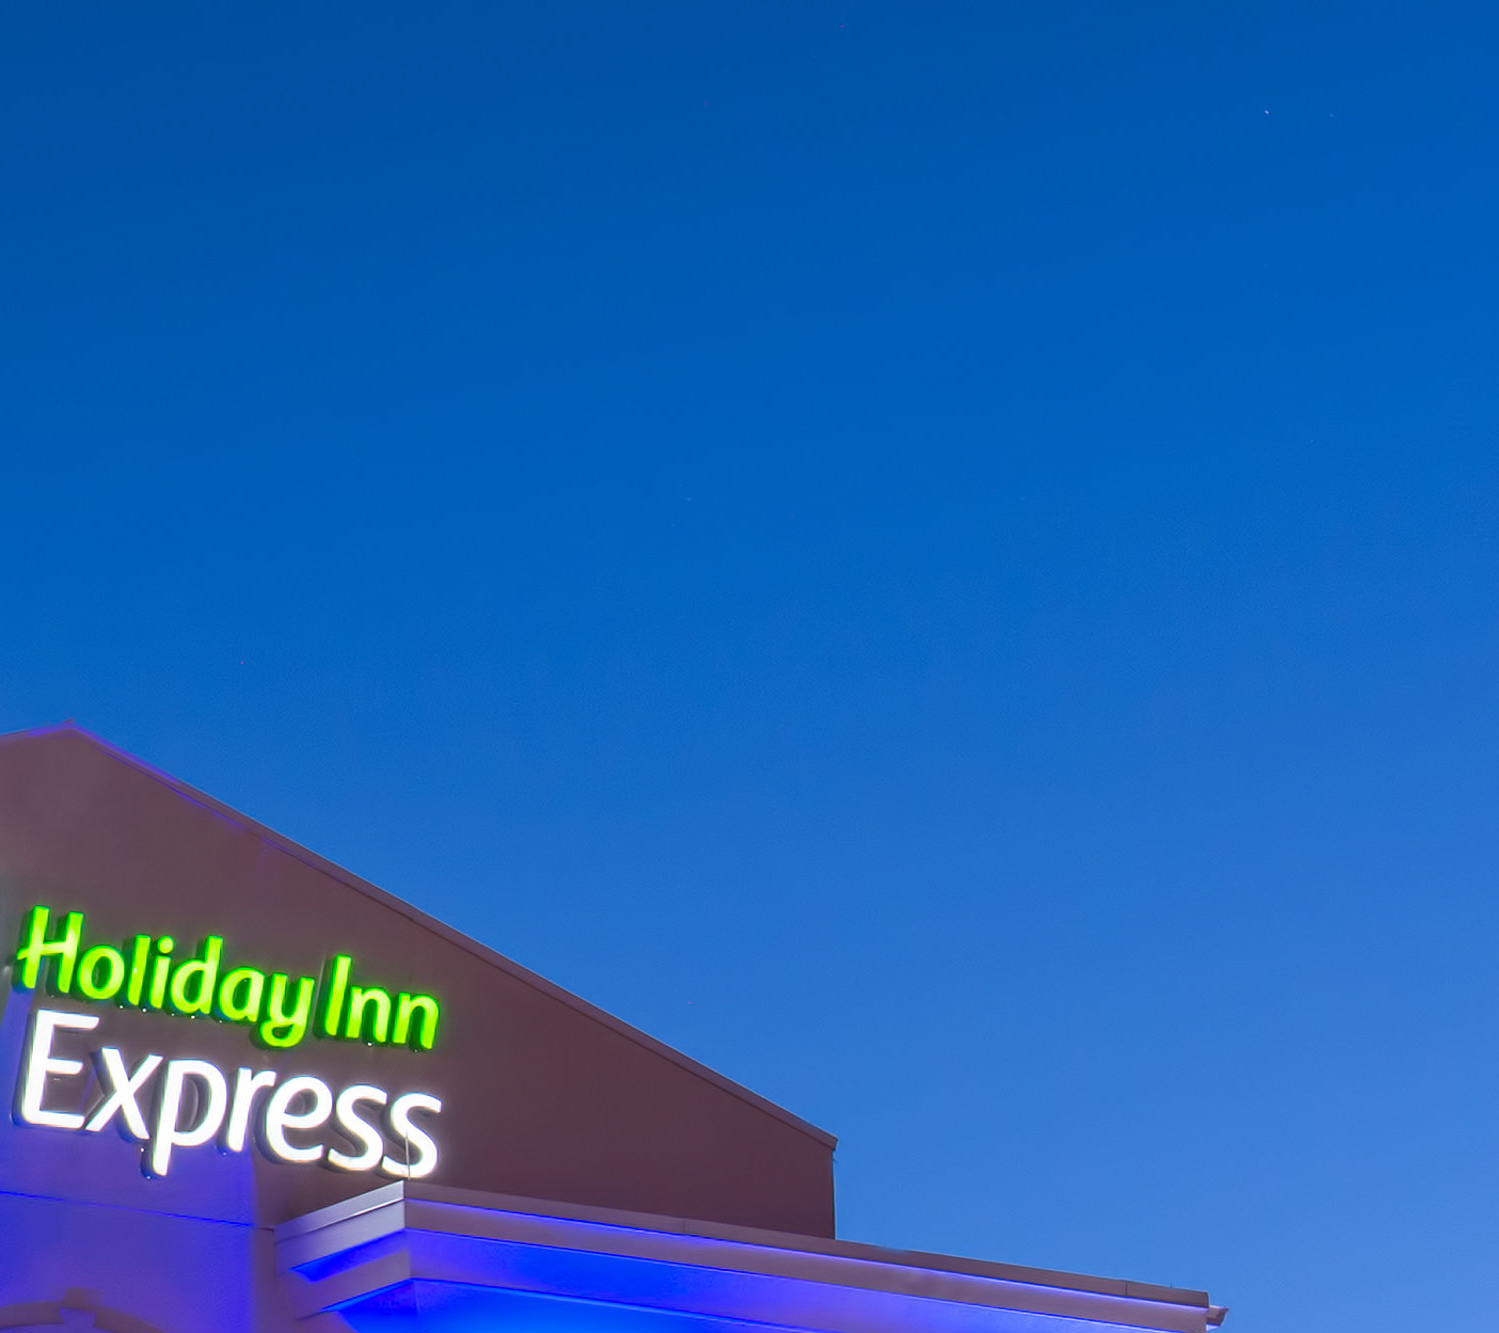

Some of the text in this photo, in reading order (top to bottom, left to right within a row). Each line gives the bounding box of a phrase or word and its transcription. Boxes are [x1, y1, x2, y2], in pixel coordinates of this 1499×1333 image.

[16, 905, 440, 1050] Holiday Inn
[20, 1009, 443, 1177] Express
